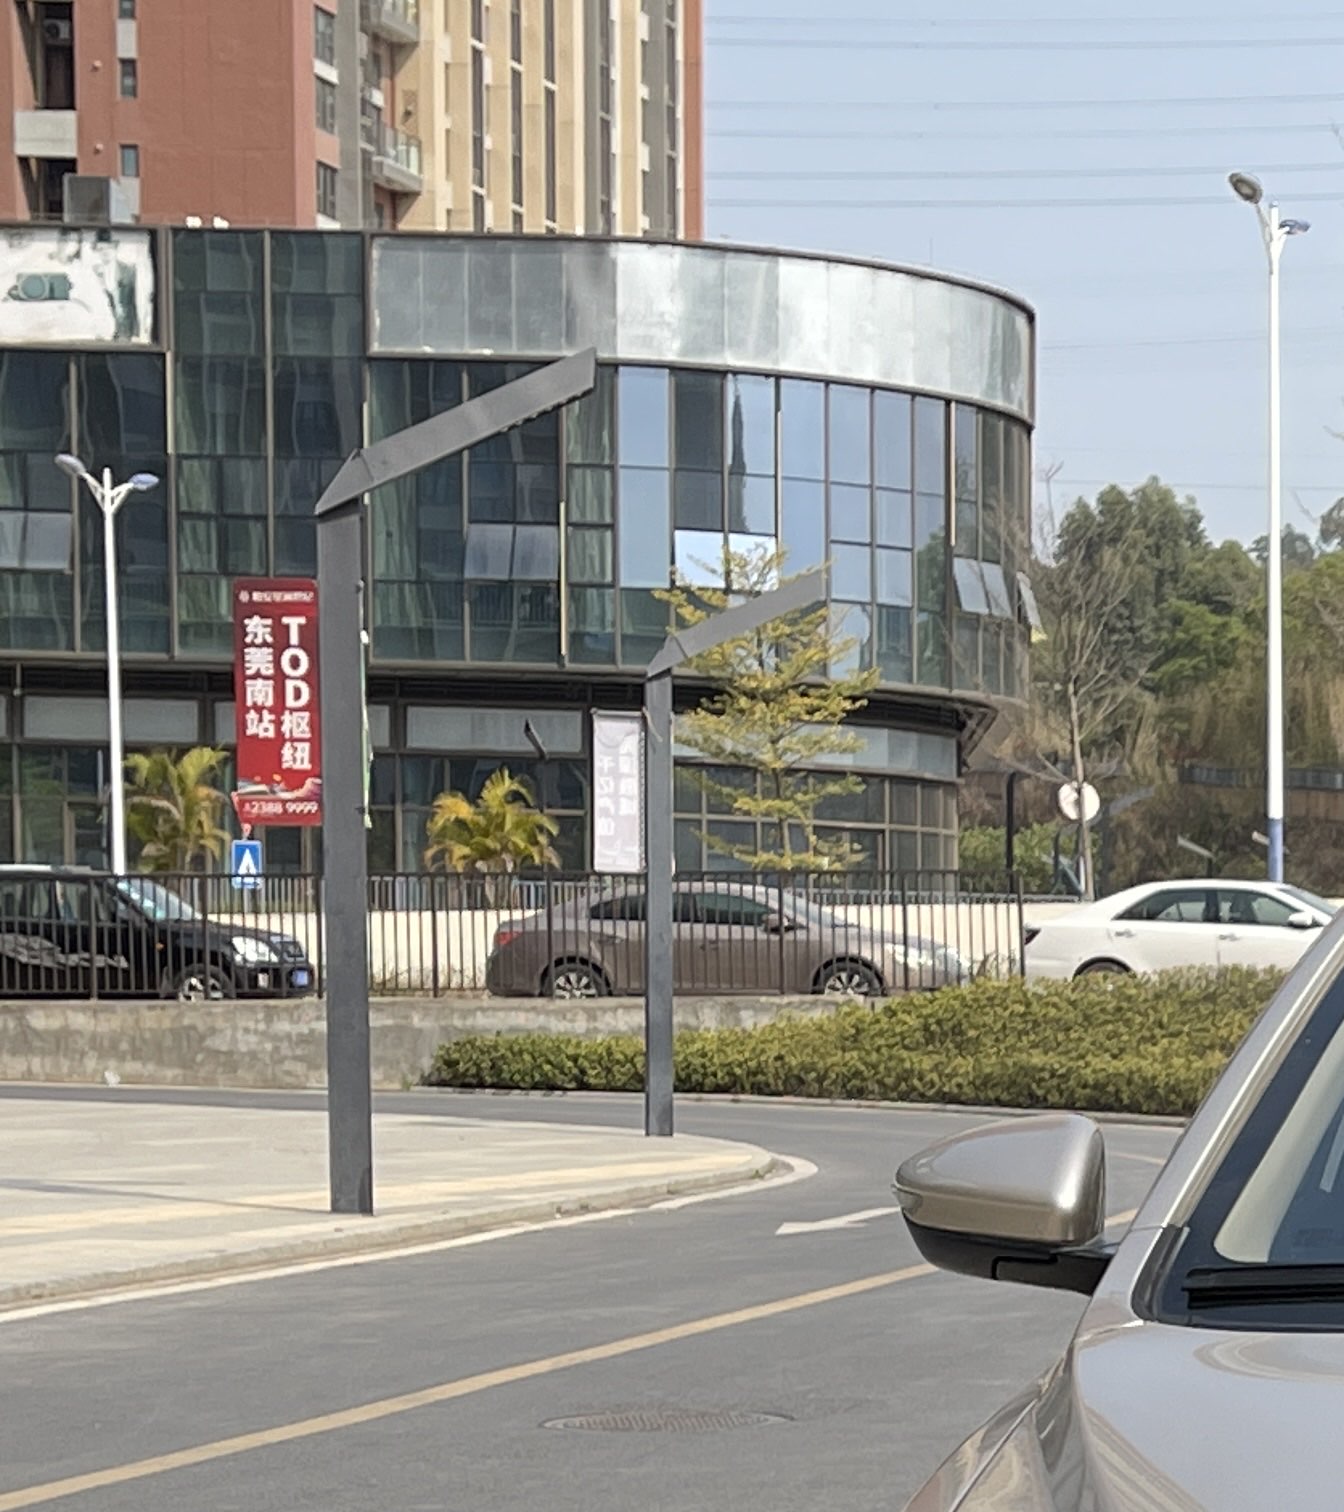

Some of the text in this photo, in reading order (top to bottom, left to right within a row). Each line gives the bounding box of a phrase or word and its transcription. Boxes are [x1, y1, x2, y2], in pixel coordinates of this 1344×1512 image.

[243, 614, 276, 739] 东莞南站
[280, 615, 313, 771] TOD枢纽
